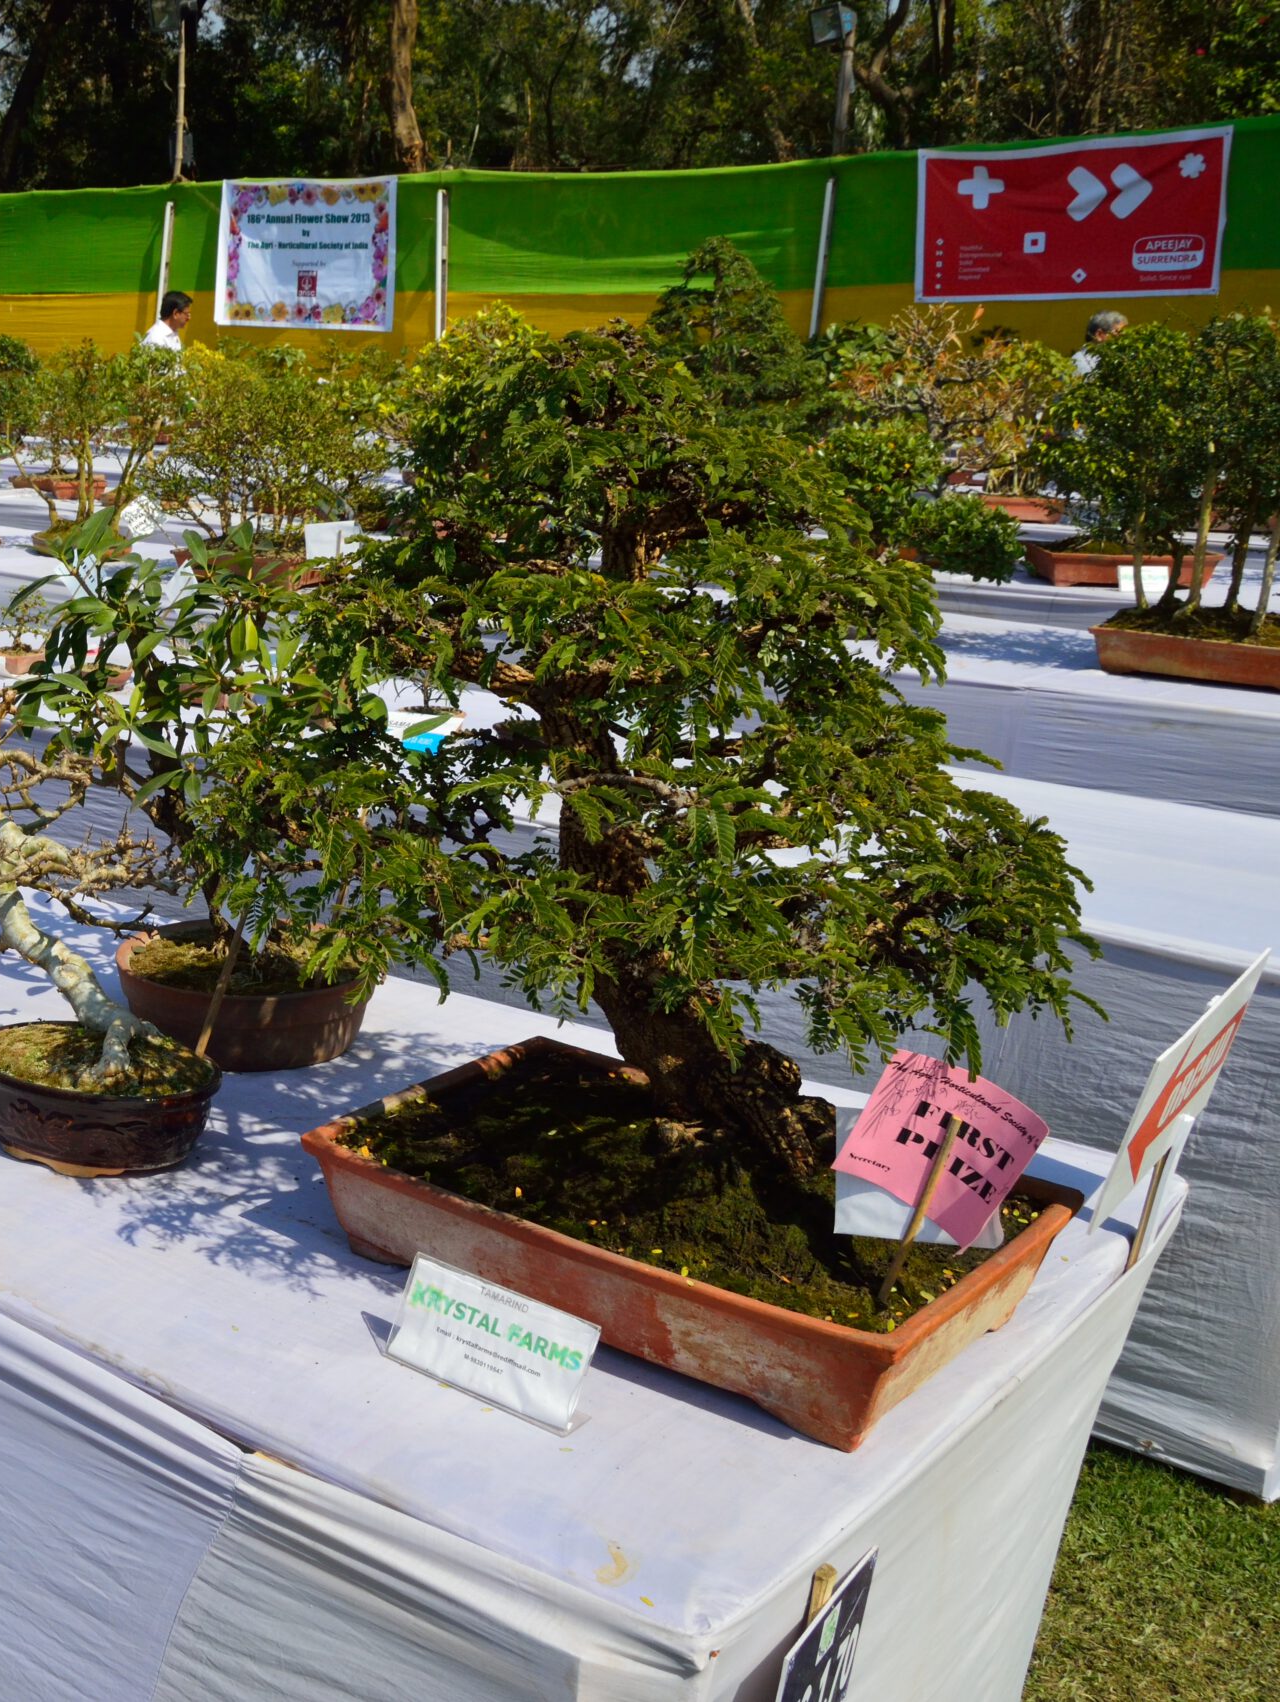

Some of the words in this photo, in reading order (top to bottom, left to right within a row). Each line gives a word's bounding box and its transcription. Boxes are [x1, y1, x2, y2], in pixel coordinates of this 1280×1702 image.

[266, 214, 293, 224] Annual
[294, 214, 324, 224] Flower
[325, 213, 349, 224] Show
[350, 213, 370, 223] 2013
[302, 229, 310, 237] by
[260, 242, 273, 250] Agri
[319, 242, 343, 250] Society
[352, 242, 369, 250] India
[1144, 239, 1193, 252] APEEJAY
[1137, 254, 1197, 265] SURRENDRA
[891, 1060, 908, 1073] The
[1000, 1112, 1029, 1137] Society
[915, 1100, 1015, 1171] FIRST
[847, 1152, 892, 1172] Secretary
[479, 1285, 529, 1313] TAMARIND
[409, 1279, 501, 1338] KRYSTAL
[506, 1323, 584, 1371] FARMS
[436, 1326, 452, 1338] Email
